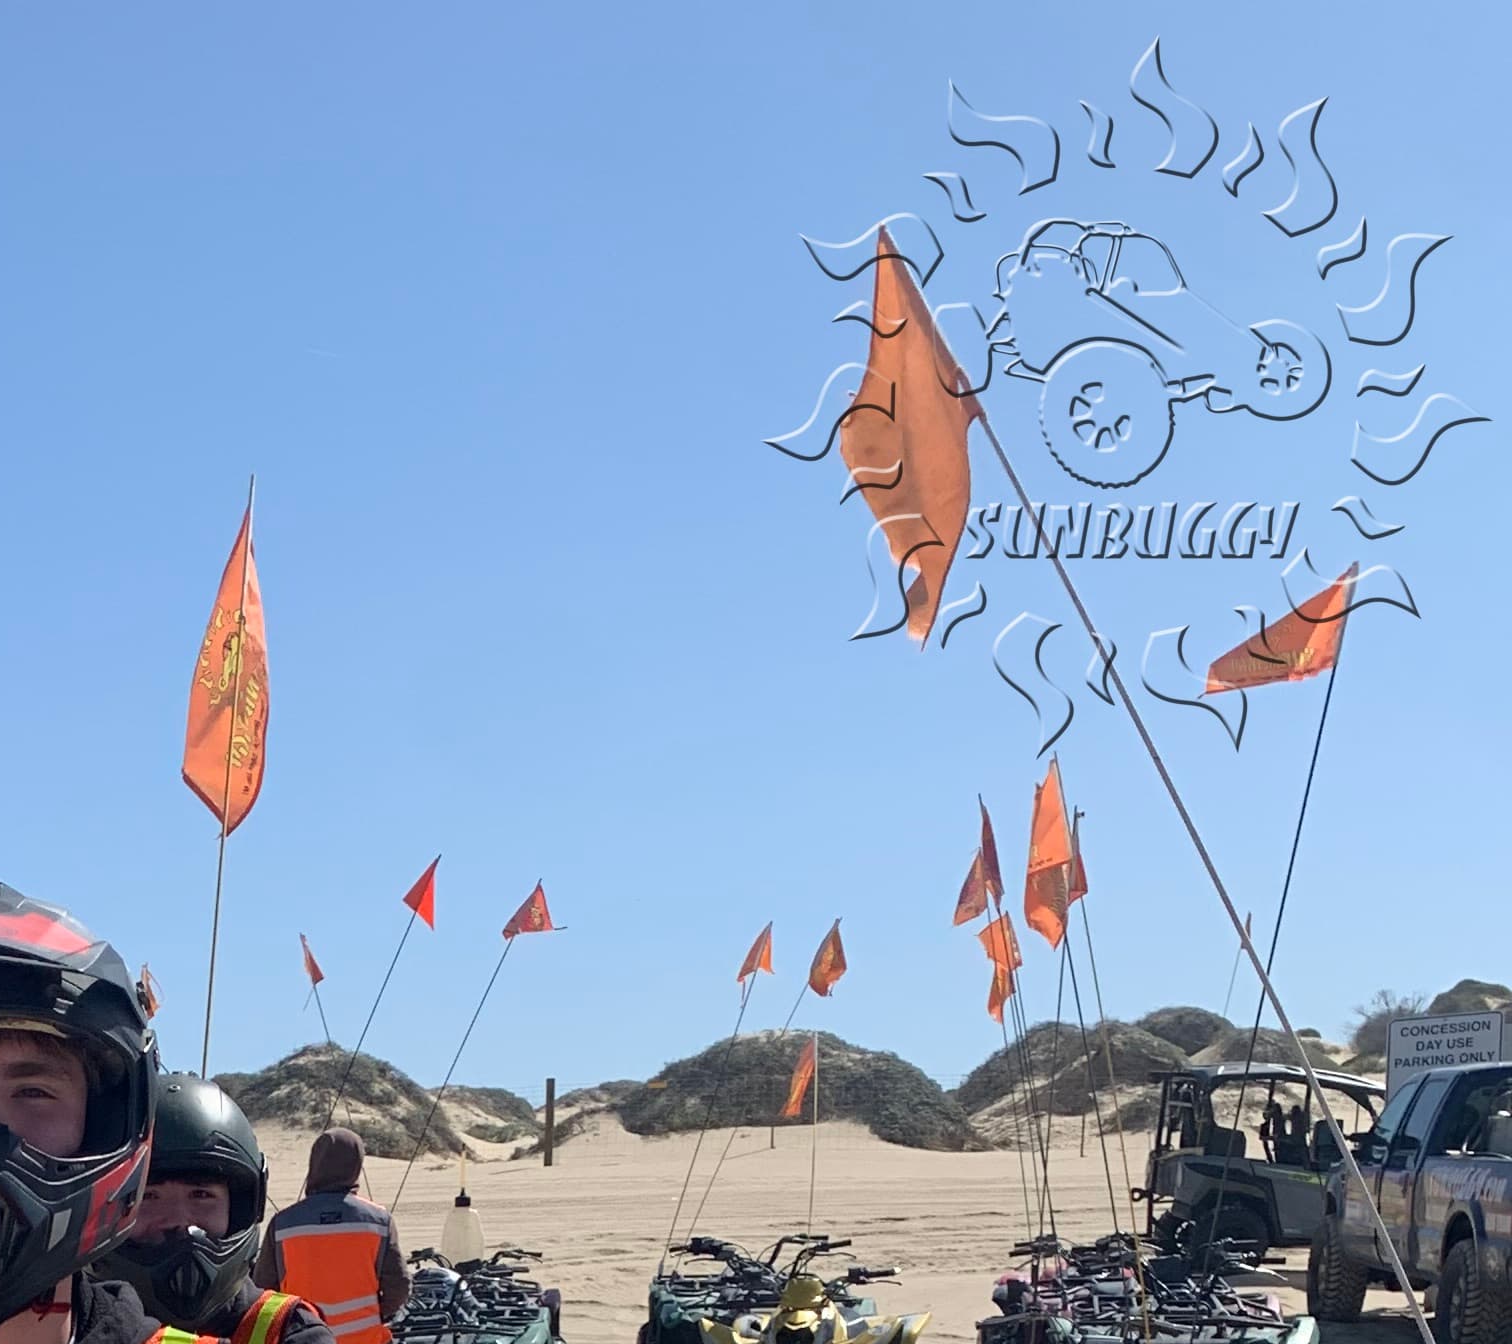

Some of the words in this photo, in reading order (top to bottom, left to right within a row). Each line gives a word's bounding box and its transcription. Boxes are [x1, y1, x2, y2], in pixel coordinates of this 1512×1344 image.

[1400, 1020, 1491, 1038] CONCESSION
[1415, 1039, 1442, 1052] DAY
[1447, 1037, 1474, 1049] USE
[1394, 1054, 1455, 1069] PARKING
[1459, 1050, 1495, 1064] ONLY
